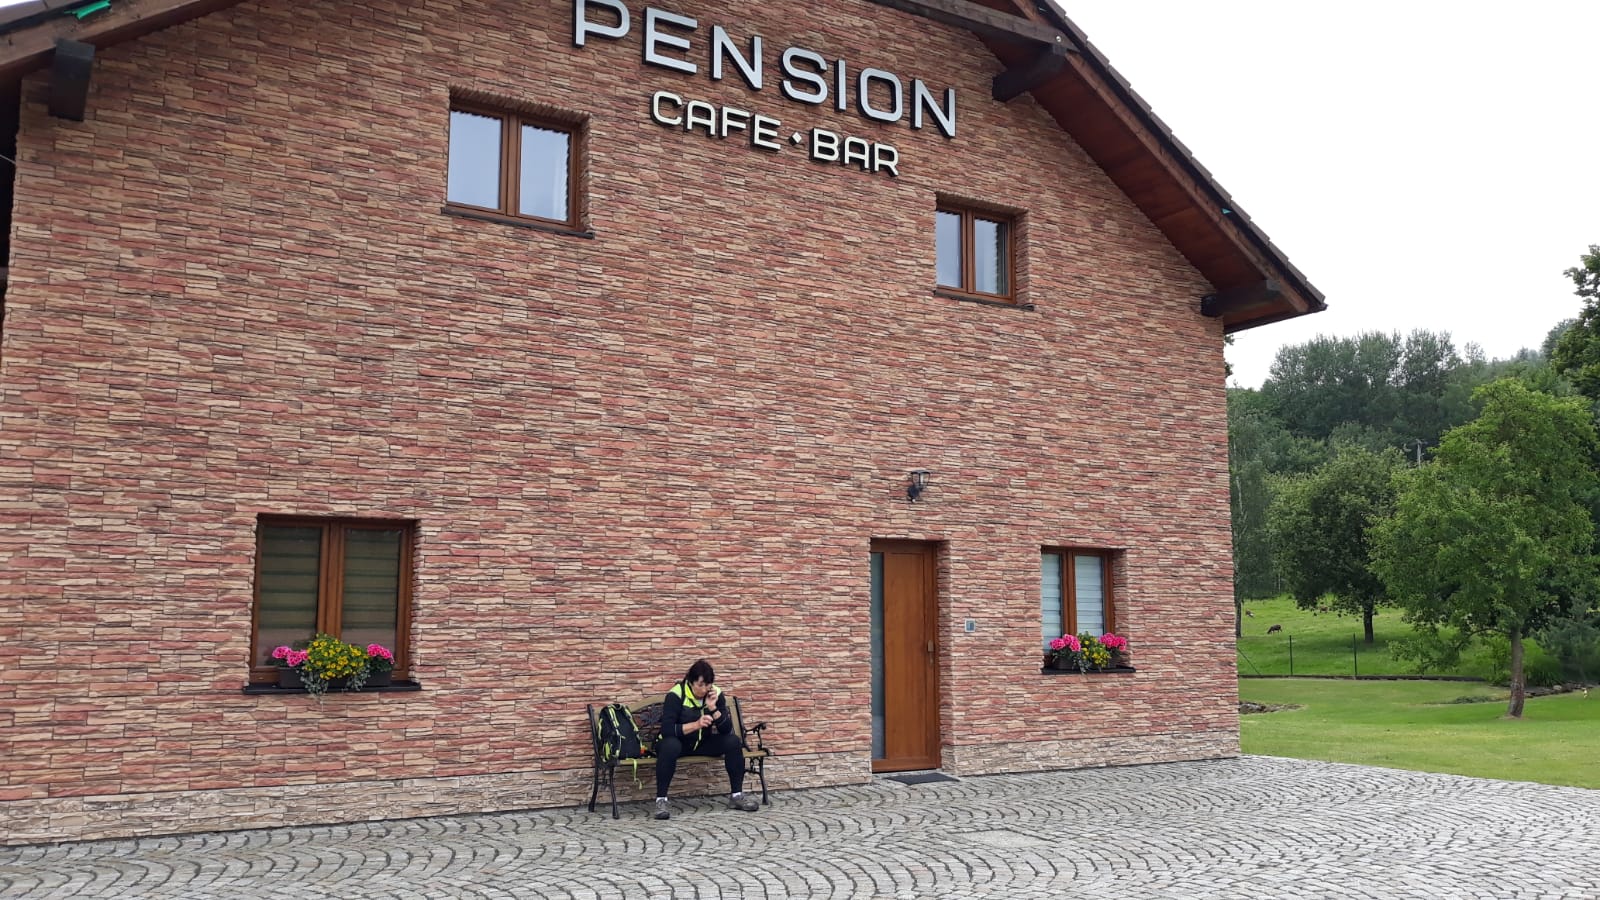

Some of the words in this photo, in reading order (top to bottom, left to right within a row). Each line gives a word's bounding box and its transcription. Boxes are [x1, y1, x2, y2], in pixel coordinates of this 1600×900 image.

[573, 0, 956, 138] PENSION
[651, 91, 781, 150] CAFE
[811, 128, 899, 176] BAR
